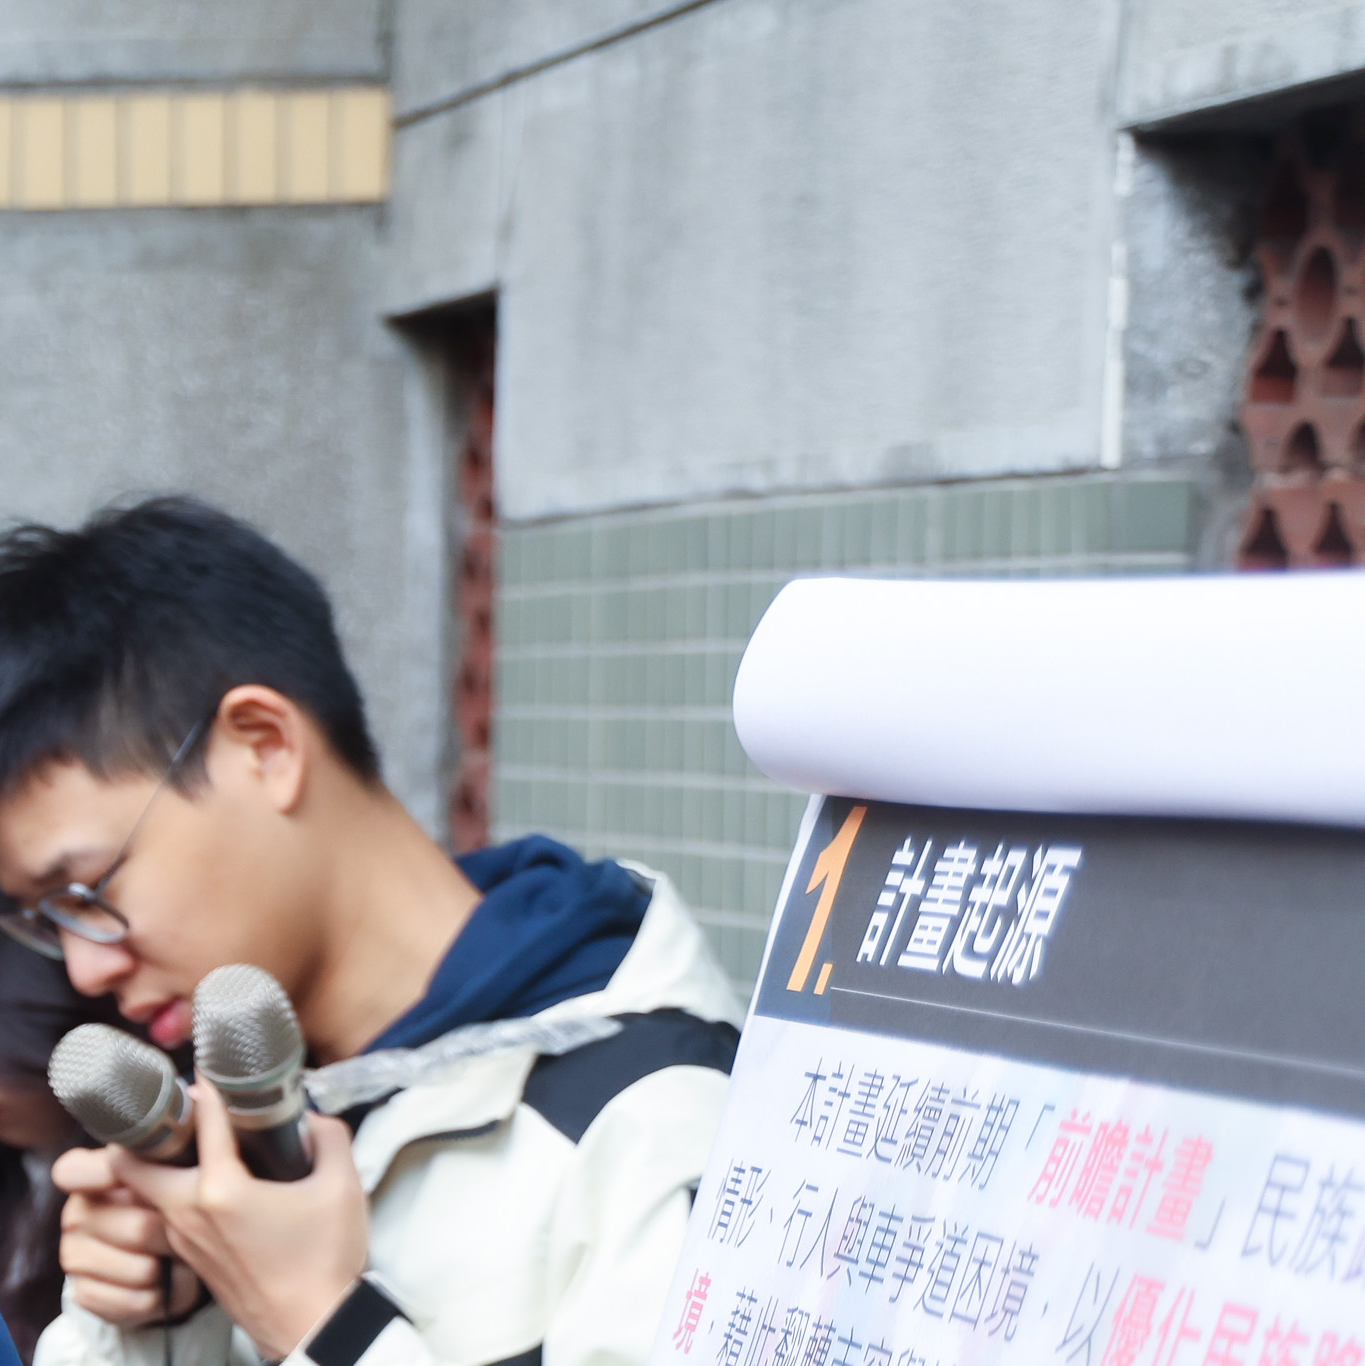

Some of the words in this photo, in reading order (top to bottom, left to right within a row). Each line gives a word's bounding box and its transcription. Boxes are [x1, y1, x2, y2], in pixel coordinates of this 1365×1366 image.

[786, 806, 867, 995] 1.
[856, 836, 1083, 986] 計畫起源
[790, 1057, 1365, 1283] 本計畫延續前期「前瞻計畫」民族
